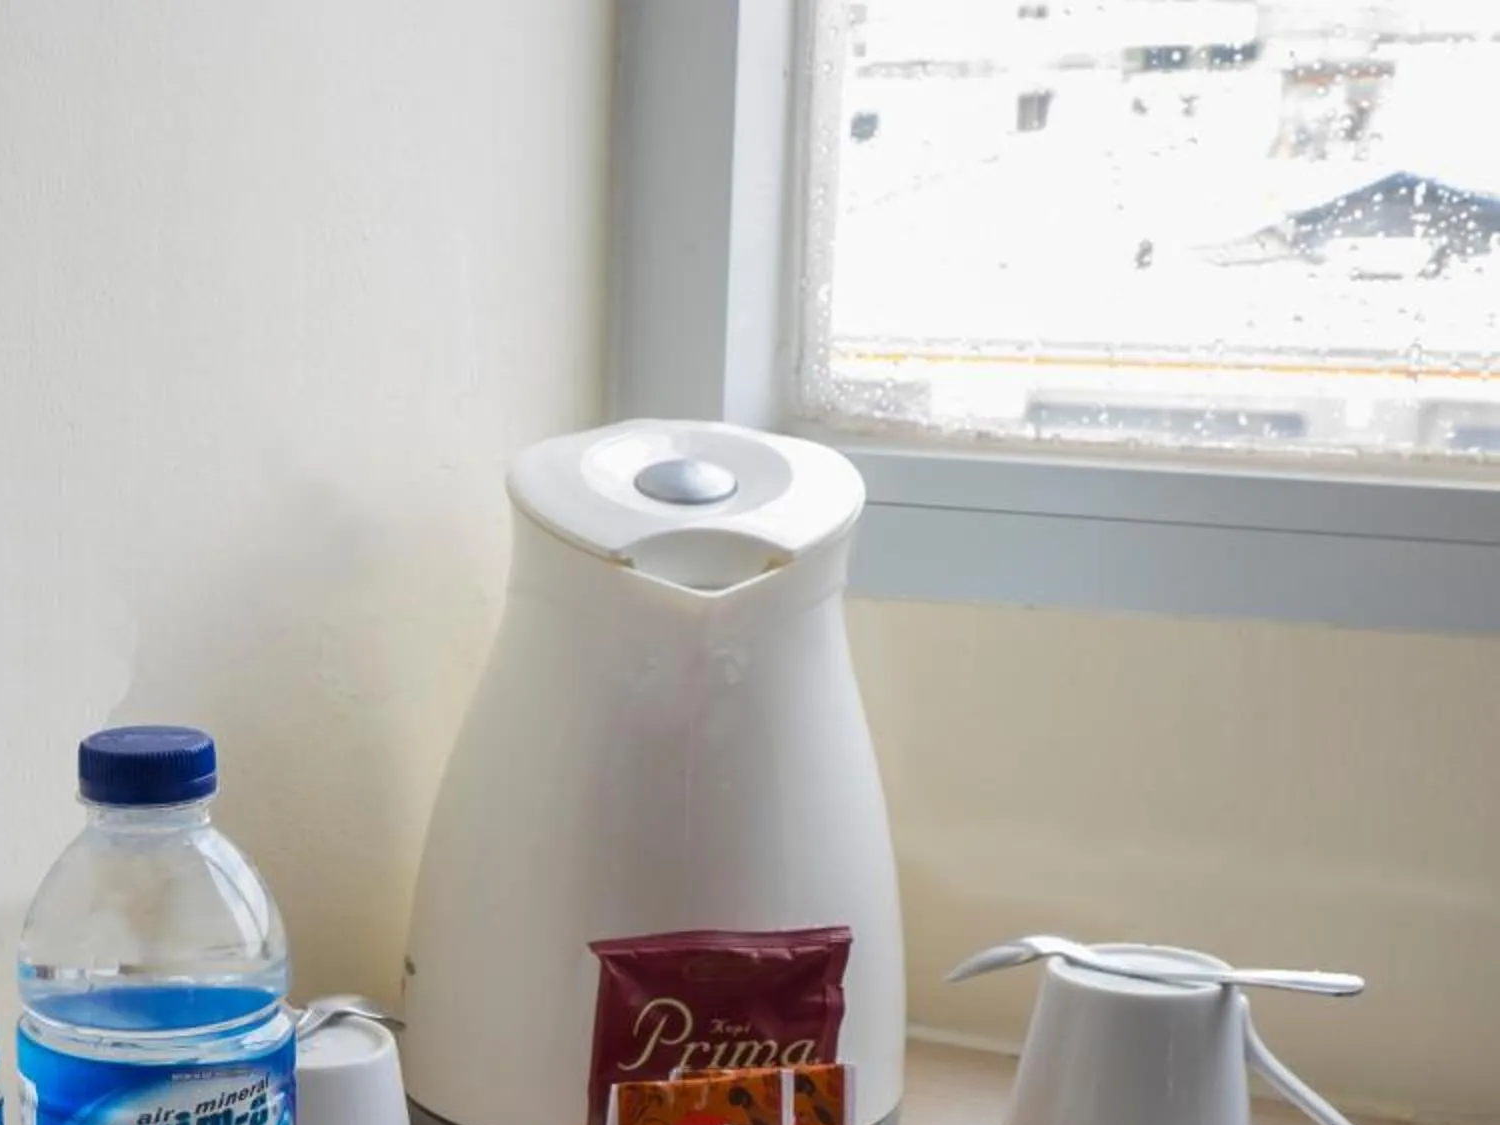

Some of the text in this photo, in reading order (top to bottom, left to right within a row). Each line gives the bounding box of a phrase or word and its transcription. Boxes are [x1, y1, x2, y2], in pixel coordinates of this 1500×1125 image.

[617, 998, 816, 1072] Prima
[137, 1071, 270, 1125] air mineral
